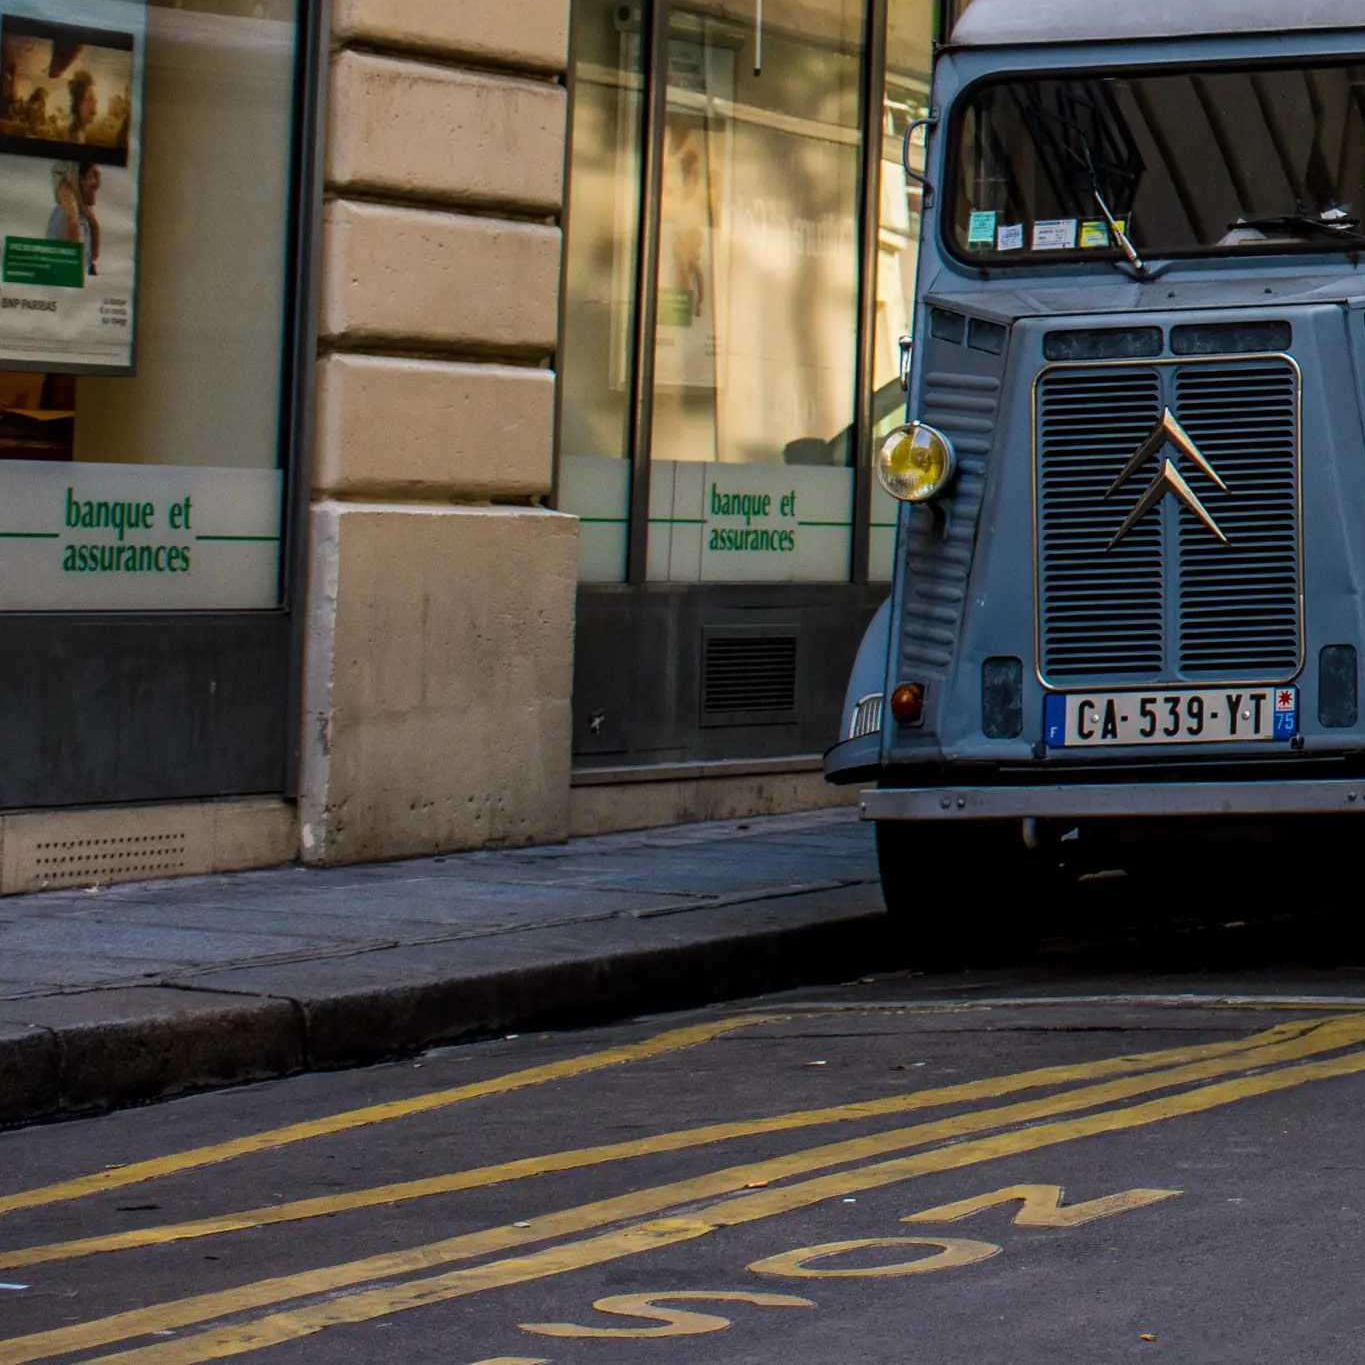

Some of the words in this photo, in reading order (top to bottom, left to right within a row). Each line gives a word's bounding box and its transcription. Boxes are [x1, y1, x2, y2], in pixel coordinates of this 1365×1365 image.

[65, 487, 155, 541] banque
[169, 495, 192, 530] et
[711, 483, 772, 525] banque
[780, 490, 796, 517] et
[709, 528, 796, 551] assurances
[62, 543, 191, 572] assurances
[1049, 726, 1059, 738] F
[1078, 693, 1267, 740] CA-539-YT
[1275, 712, 1295, 731] 75
